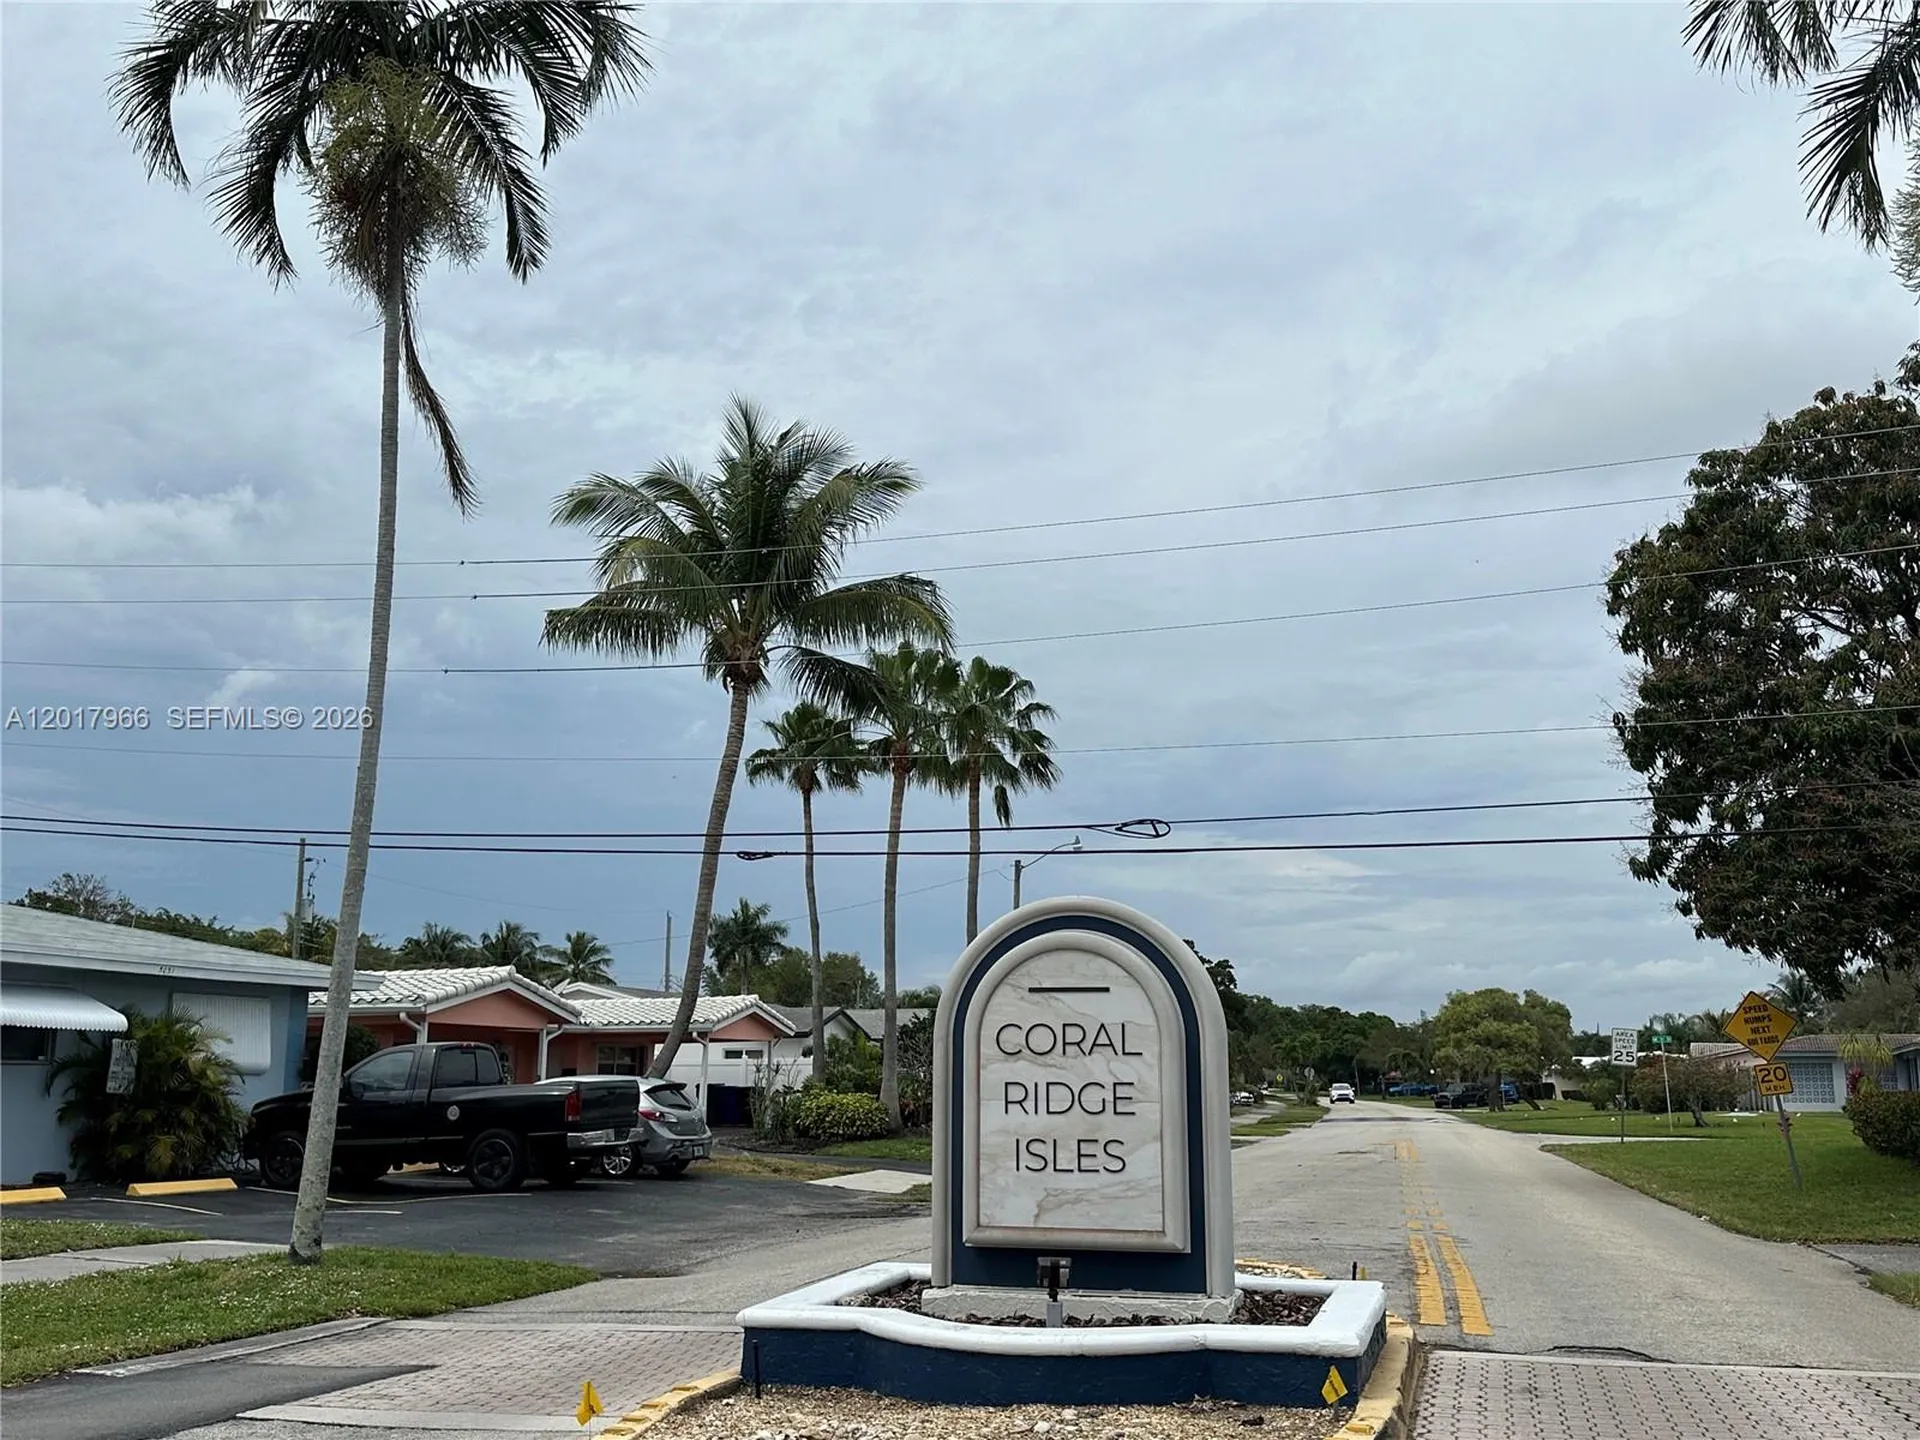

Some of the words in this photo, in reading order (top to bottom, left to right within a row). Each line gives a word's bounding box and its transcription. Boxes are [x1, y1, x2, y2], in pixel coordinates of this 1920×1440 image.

[1743, 1004, 1768, 1014] SPEED
[1744, 1014, 1772, 1025] HUMPS
[1750, 1025, 1771, 1035] NEXT
[995, 1023, 1143, 1056] CORAL
[1613, 1050, 1635, 1062] 25
[1758, 1066, 1787, 1083] 20
[1004, 1081, 1136, 1115] RIDGE
[1015, 1138, 1126, 1173] ISLES
